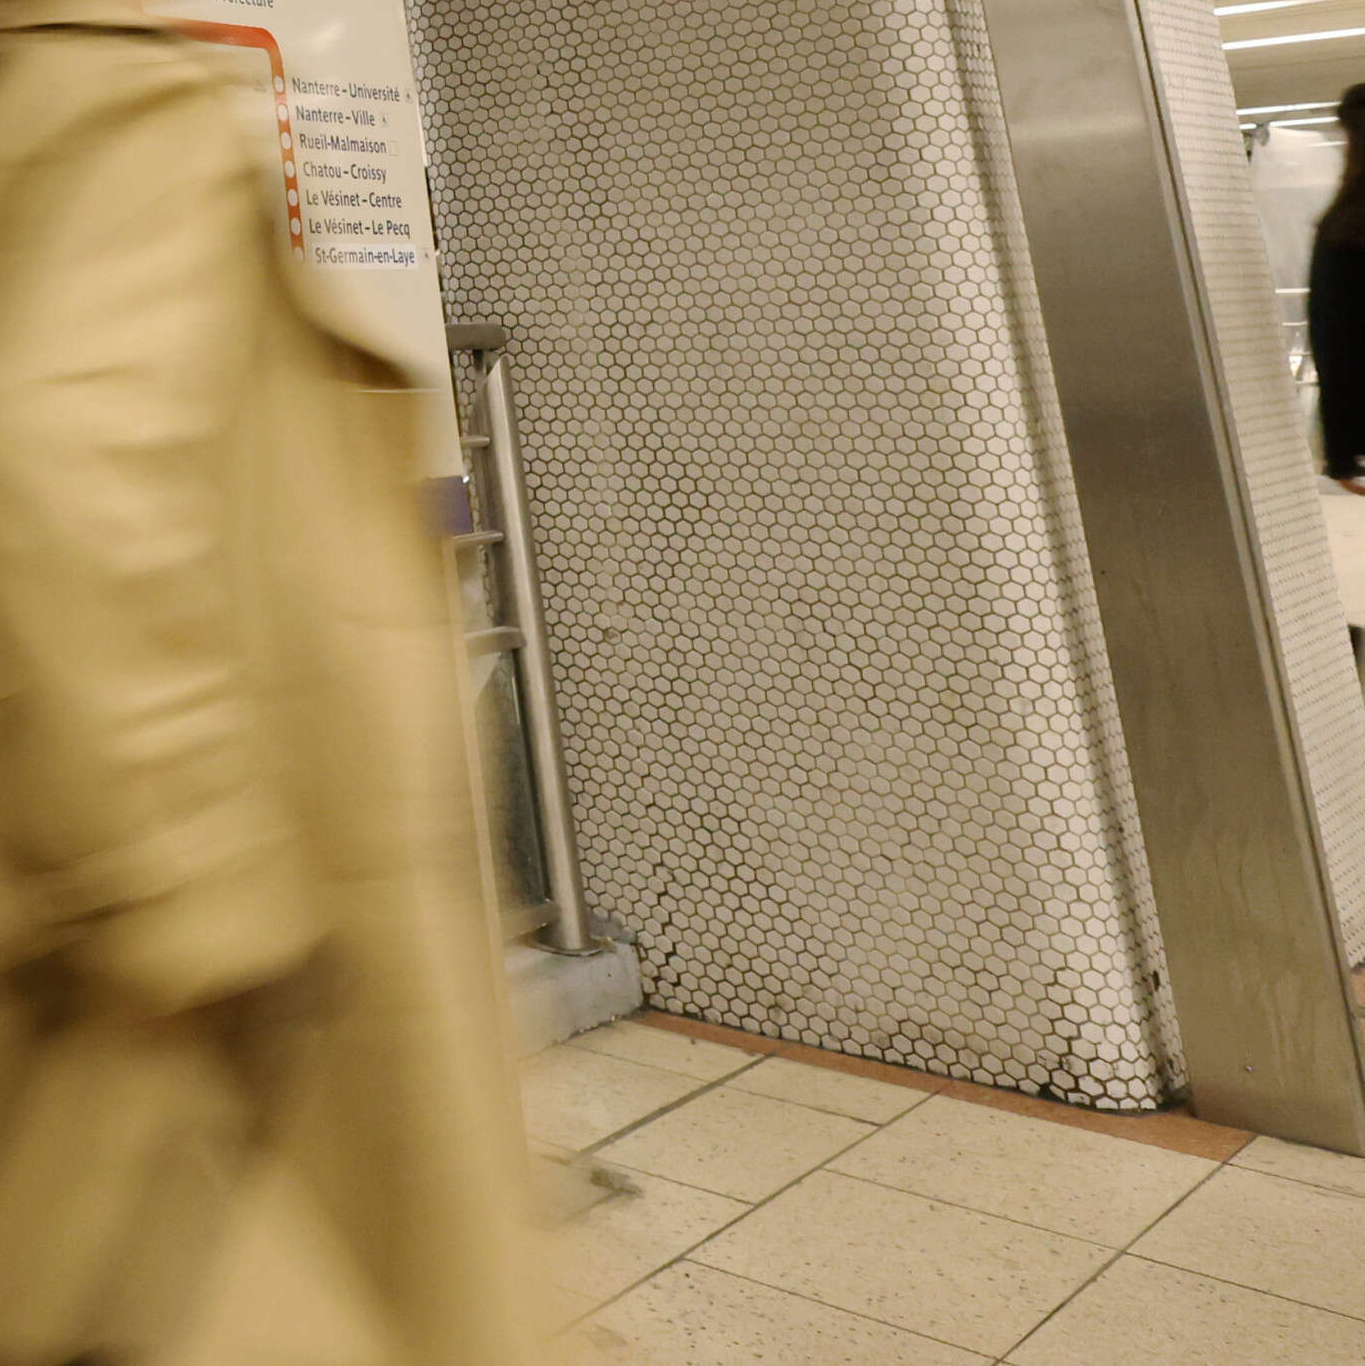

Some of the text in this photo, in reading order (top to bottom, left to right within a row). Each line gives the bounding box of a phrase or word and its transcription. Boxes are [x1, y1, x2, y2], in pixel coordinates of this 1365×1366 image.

[292, 77, 340, 96] Nanterre
[349, 83, 400, 102] Université
[296, 105, 344, 124] Nanterre
[352, 110, 375, 127] Ville
[299, 133, 386, 153] Rueil-Malmaison
[303, 161, 341, 179] Chatou
[350, 164, 387, 184] Croissy
[306, 190, 319, 205] Le
[322, 189, 360, 207] Vésinet
[369, 192, 402, 208] Centre
[309, 218, 322, 234] Le
[325, 218, 362, 236] Vésinet
[371, 218, 384, 235] Le
[386, 219, 410, 243] Pecq
[315, 247, 415, 267] St-Germain-en-Laye
